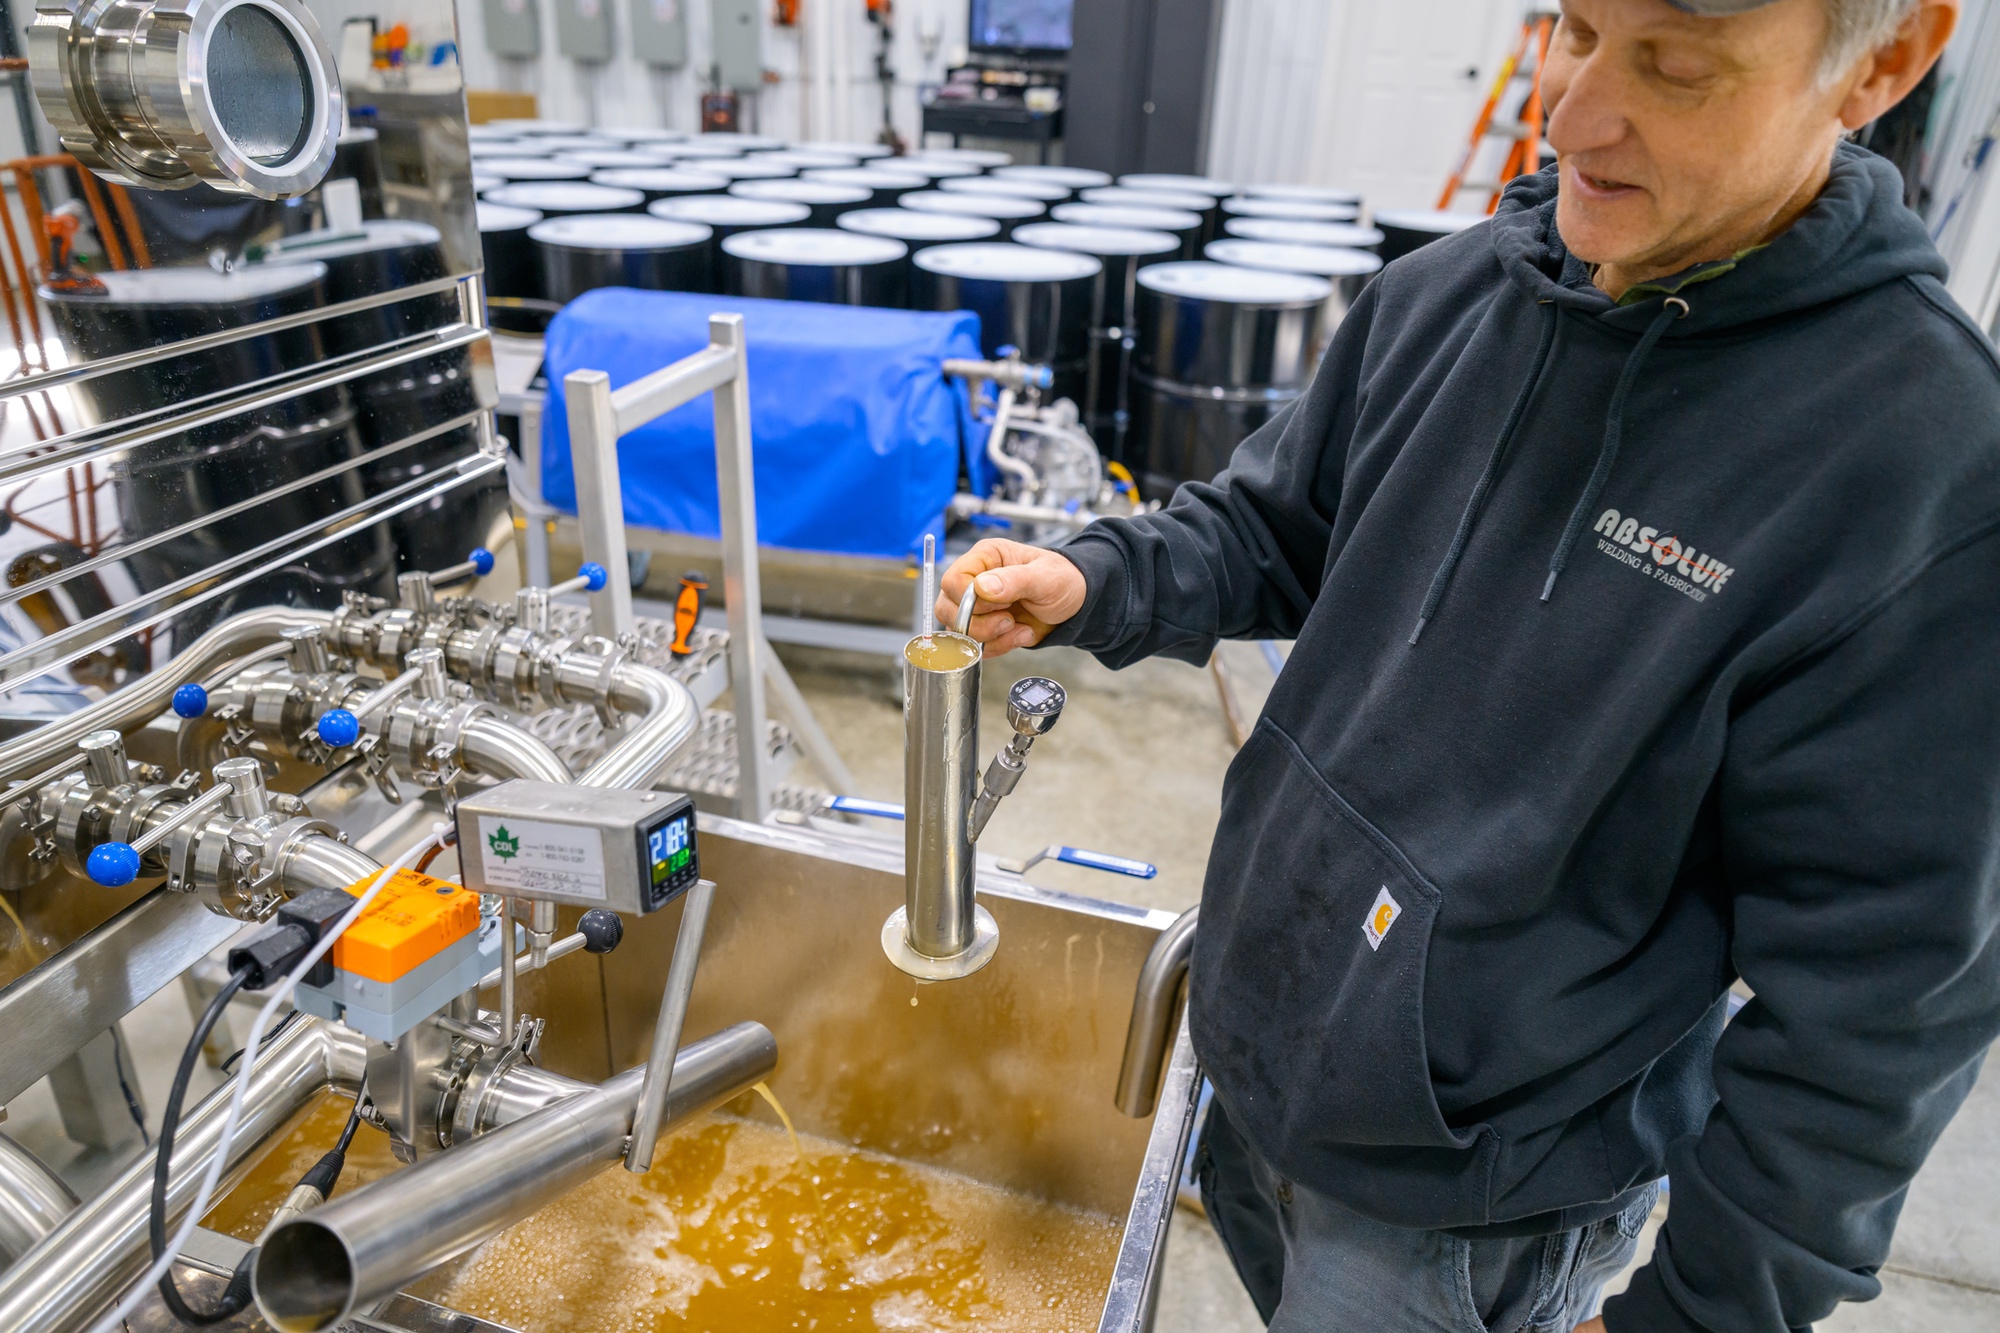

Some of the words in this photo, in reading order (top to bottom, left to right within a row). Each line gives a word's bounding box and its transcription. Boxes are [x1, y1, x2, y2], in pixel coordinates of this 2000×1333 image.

[1593, 508, 1735, 594] ABSOLUTE
[1596, 538, 1642, 569] WELDING
[1642, 563, 1653, 575] &
[1653, 569, 1708, 603] FABRICATION
[494, 841, 515, 852] CDL
